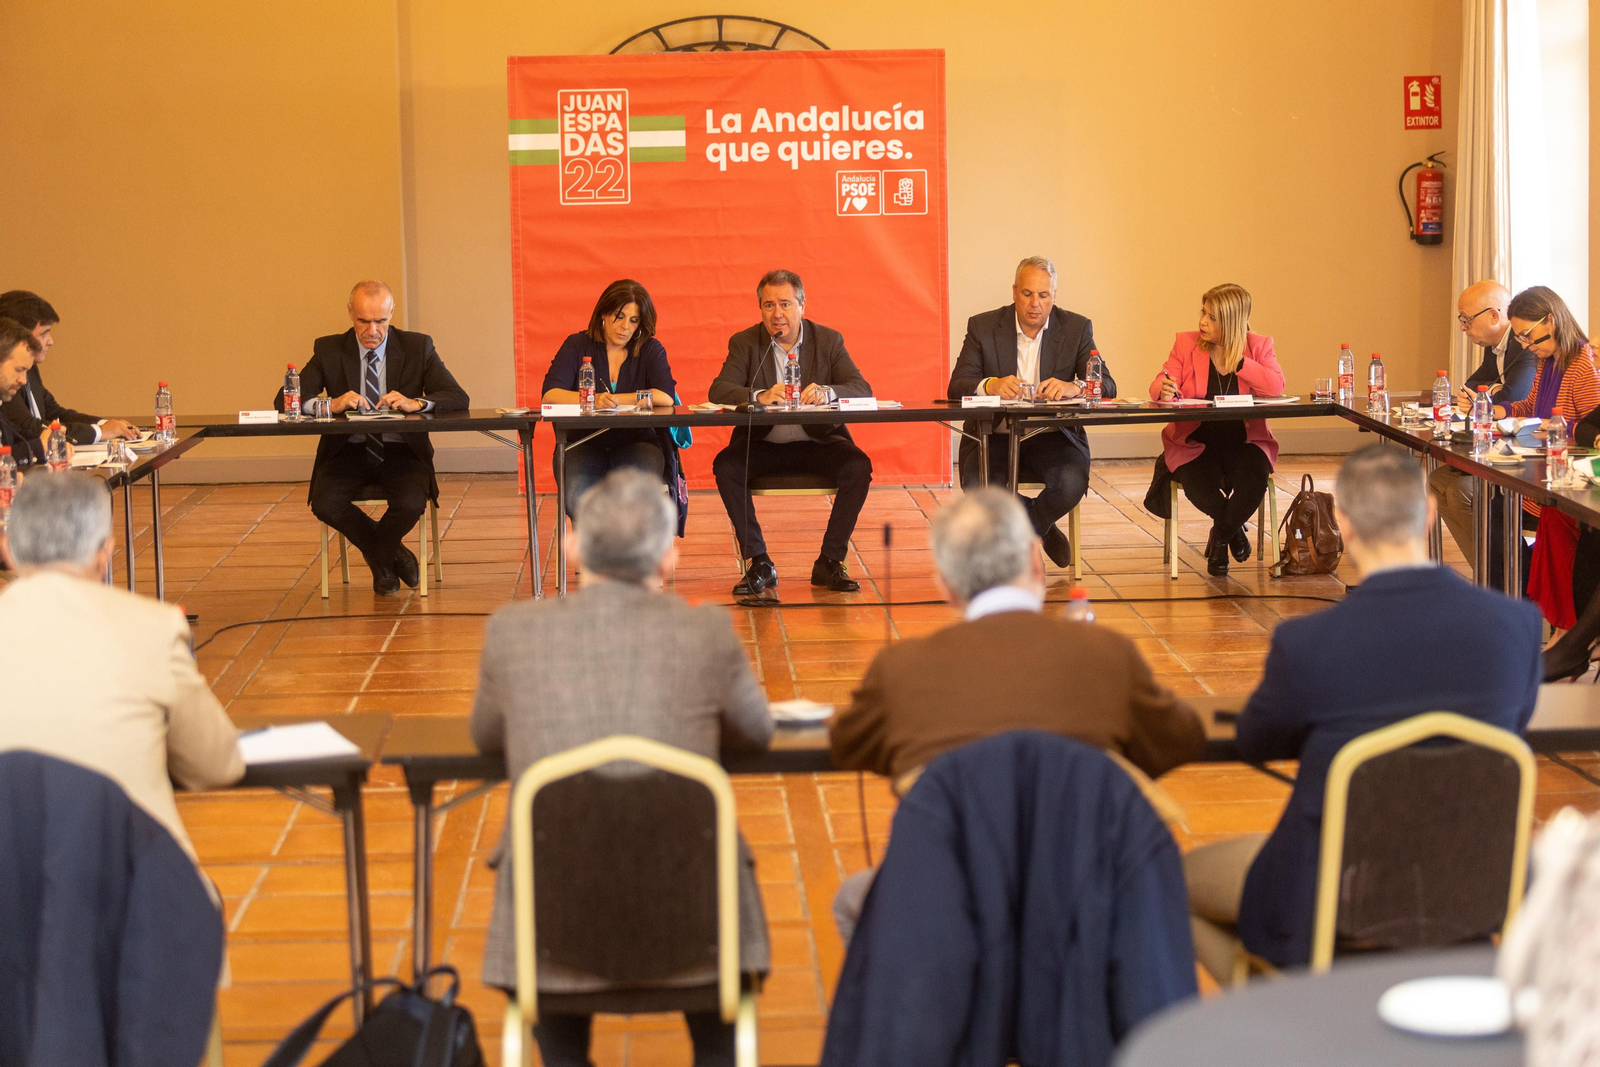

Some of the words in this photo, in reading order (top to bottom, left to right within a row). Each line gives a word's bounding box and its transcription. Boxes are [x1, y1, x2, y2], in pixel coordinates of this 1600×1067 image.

[563, 94, 622, 112] JUAN
[563, 112, 623, 132] ESPA
[706, 109, 742, 134] La
[750, 102, 924, 133] Andalucía
[1406, 116, 1439, 126] EXTINTOR
[564, 132, 625, 157] DAS
[705, 141, 770, 171] que
[777, 132, 913, 170] quieres.
[564, 157, 625, 200] 22
[841, 174, 876, 183] Andalucía
[841, 182, 877, 197] PSOE
